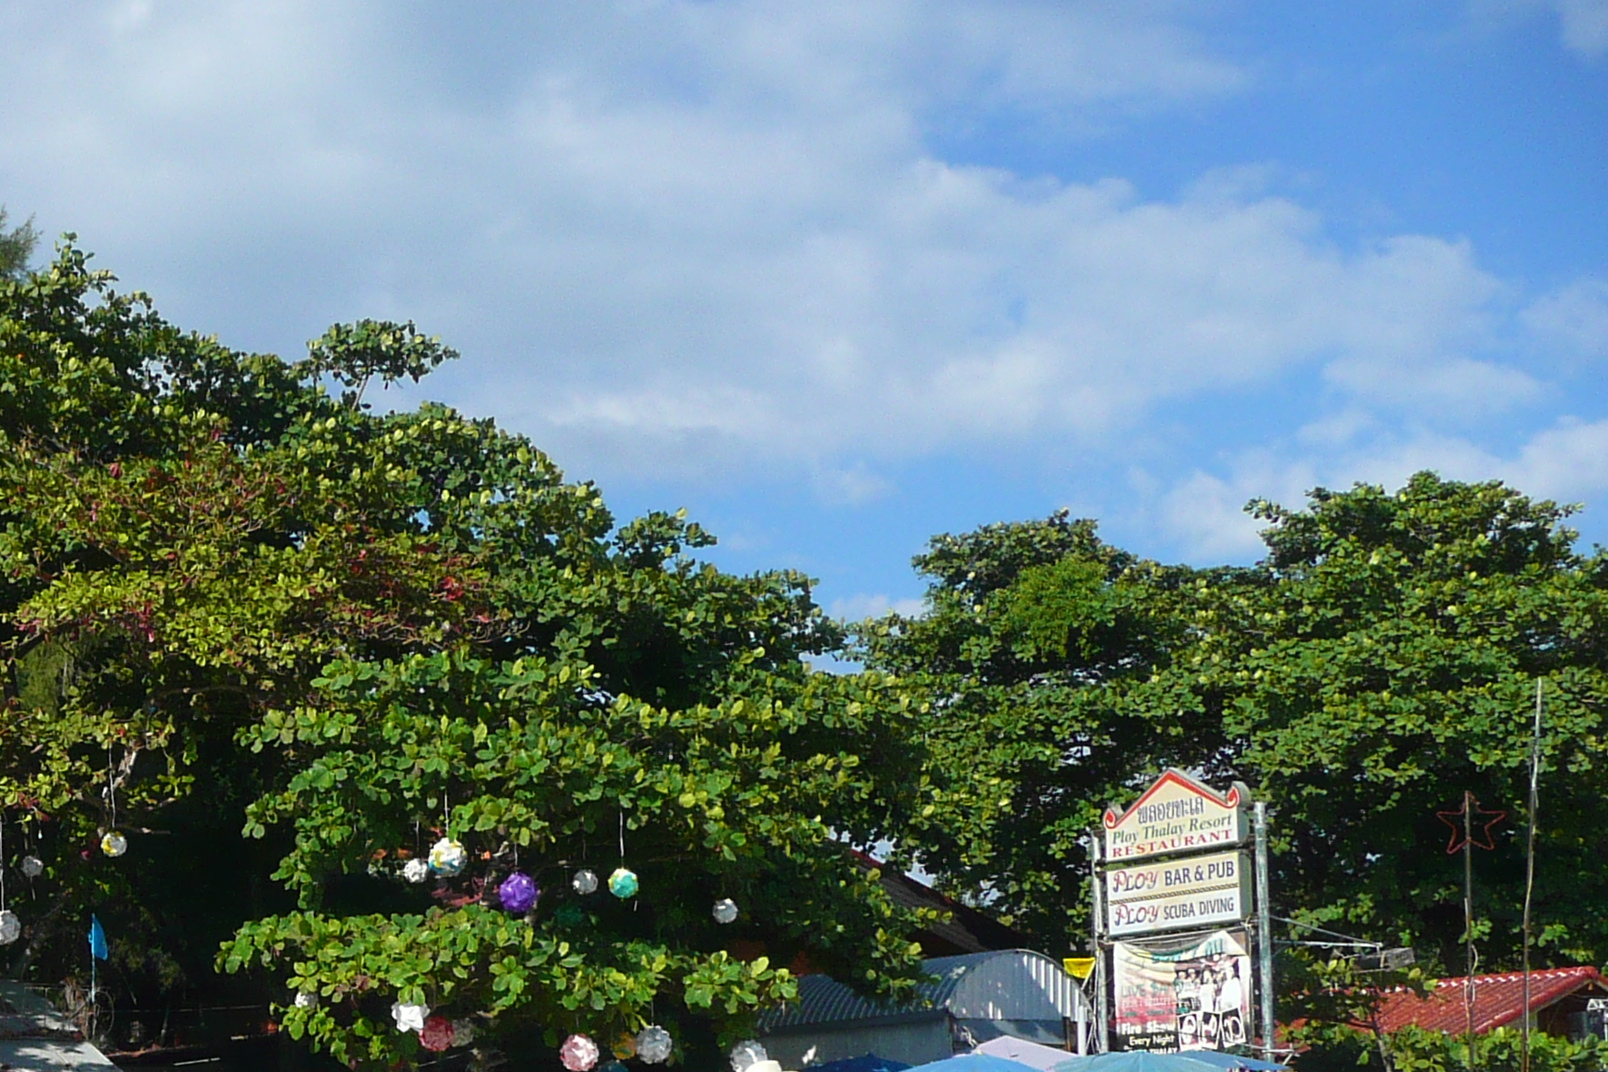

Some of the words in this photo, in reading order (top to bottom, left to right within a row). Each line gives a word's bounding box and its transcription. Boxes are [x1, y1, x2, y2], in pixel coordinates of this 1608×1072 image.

[1112, 830, 1140, 845] Ploy
[1143, 823, 1185, 839] Thalay
[1189, 814, 1232, 832] Resort
[1112, 829, 1233, 858] RESTAURANT
[1164, 866, 1192, 886] BAR
[1194, 865, 1205, 881] &
[1207, 860, 1235, 880] PUB
[1163, 904, 1196, 920] SCUBA
[1199, 897, 1235, 916] DIVING
[1121, 1022, 1142, 1035] Fire
[1129, 1036, 1151, 1047] Every
[1152, 1034, 1175, 1046] Night
